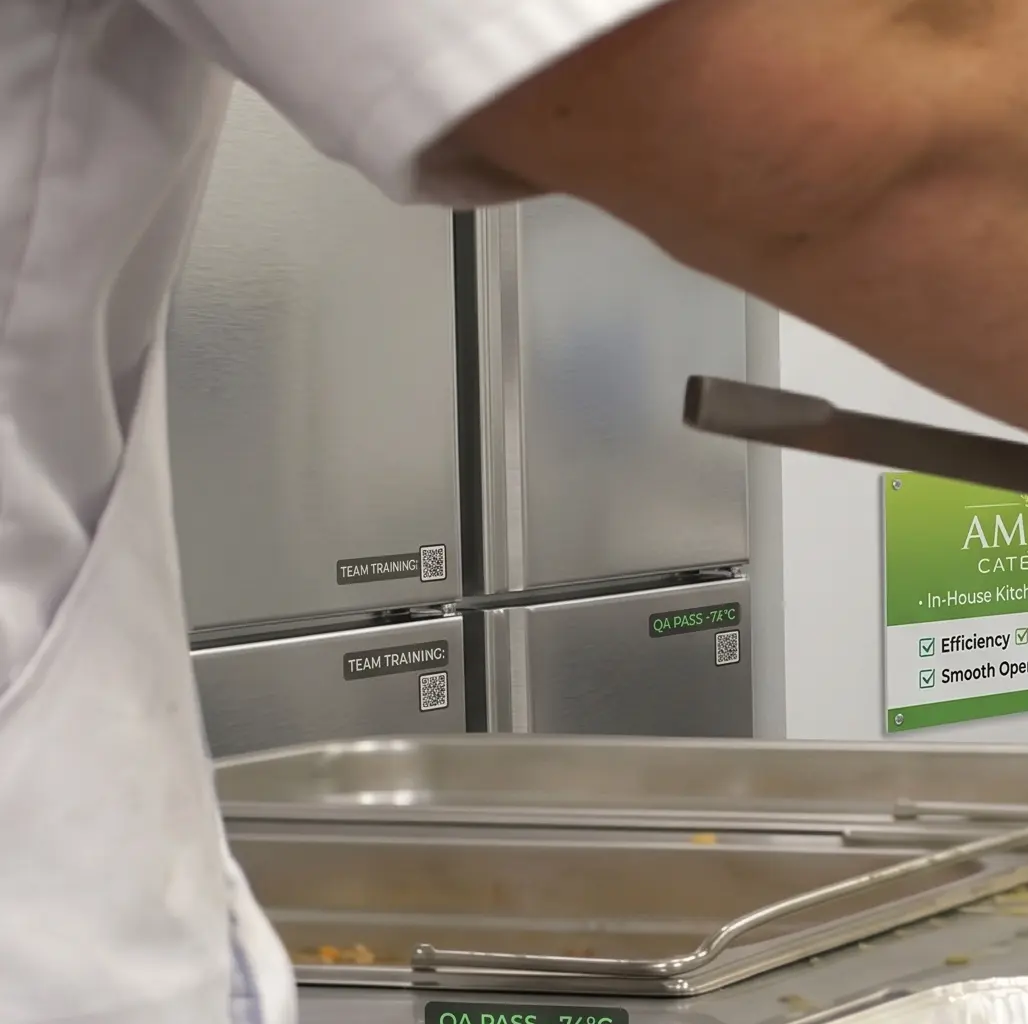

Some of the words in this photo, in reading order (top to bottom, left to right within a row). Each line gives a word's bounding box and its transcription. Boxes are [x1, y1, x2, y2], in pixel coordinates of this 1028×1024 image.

[340, 563, 369, 578] TEAM
[927, 590, 992, 609] In-House
[653, 617, 671, 633] QA
[673, 612, 703, 628] PASS
[941, 632, 1011, 654] Efficiency
[348, 655, 381, 673] TEAM
[384, 648, 445, 668] TRAINING:
[941, 661, 996, 684] Smooth
